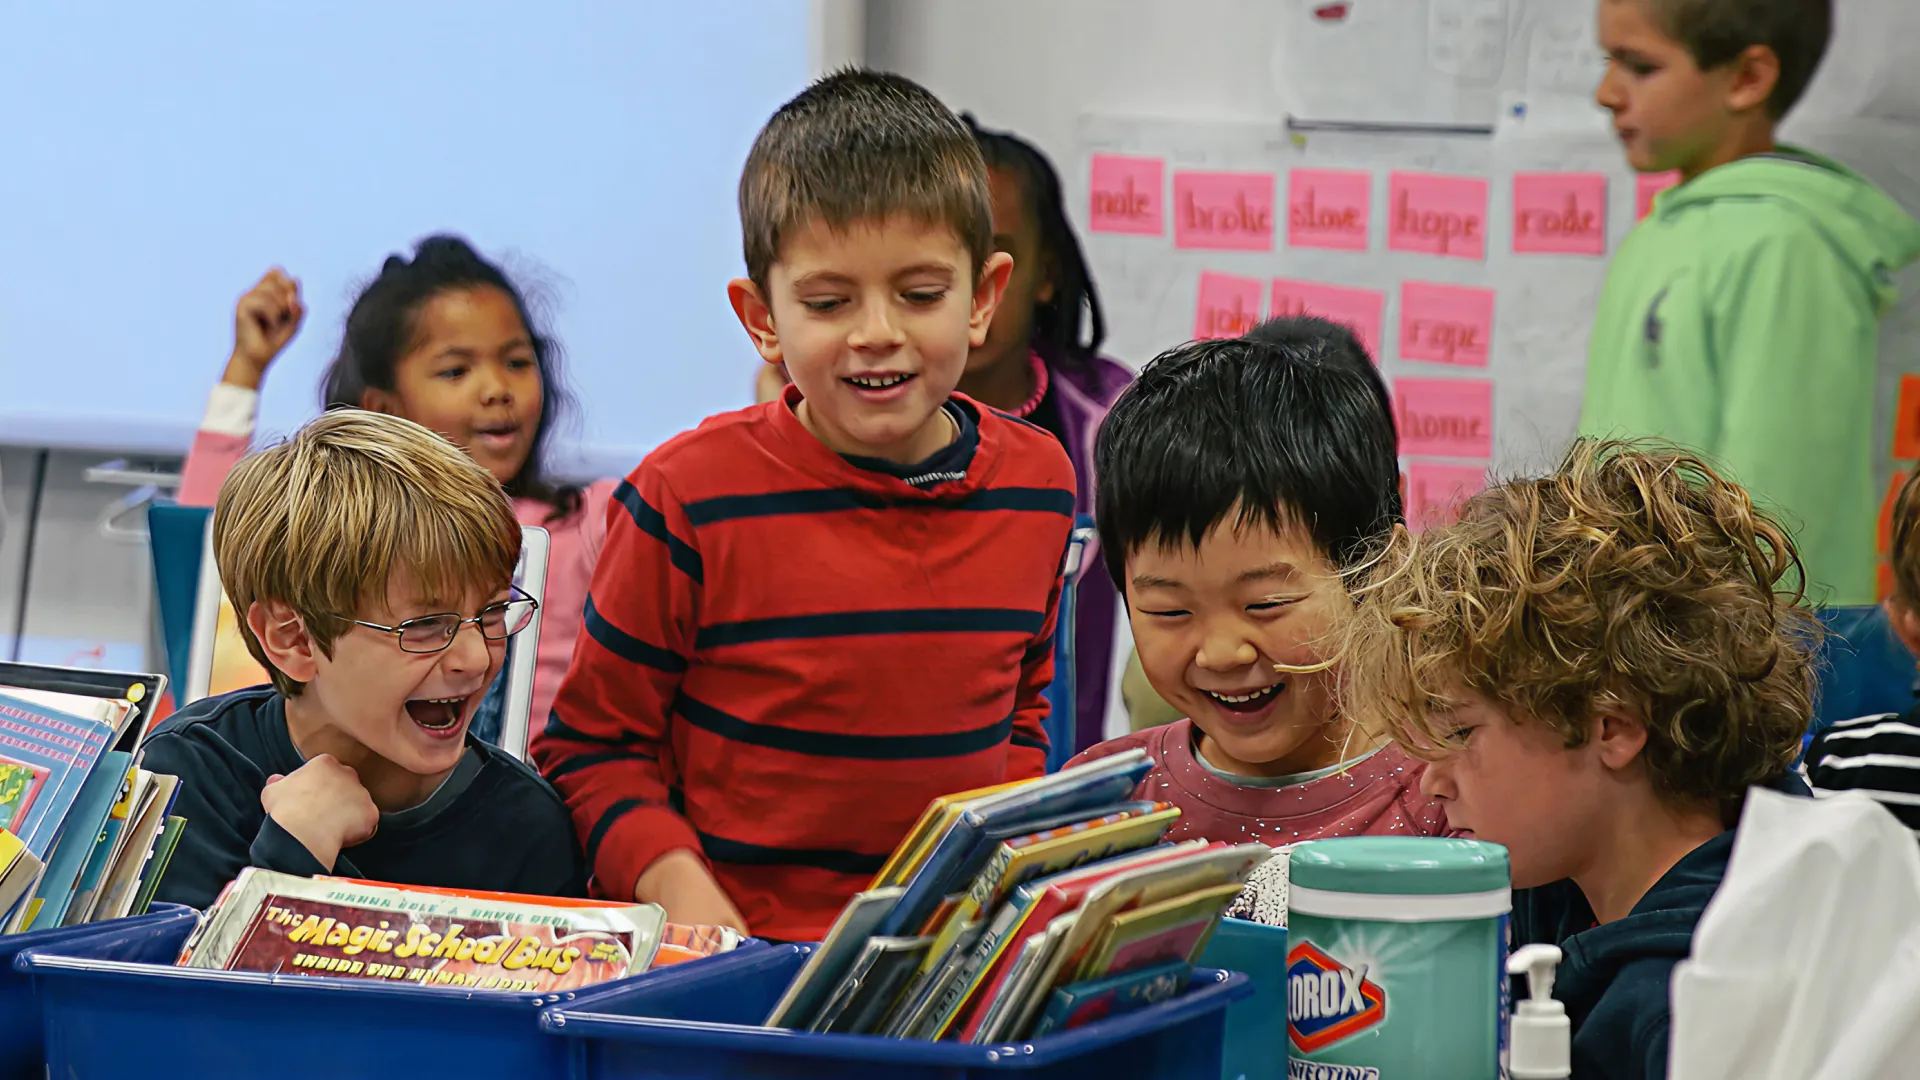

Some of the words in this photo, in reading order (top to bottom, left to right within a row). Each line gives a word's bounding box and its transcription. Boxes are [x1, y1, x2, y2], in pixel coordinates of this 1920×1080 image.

[1394, 188, 1479, 254] hope
[1515, 191, 1602, 237] rode
[1407, 318, 1486, 363] rope
[1398, 392, 1489, 443] home
[265, 906, 304, 928] The
[287, 914, 400, 956] Magic
[394, 921, 516, 965] School
[501, 935, 582, 975] Bus
[292, 953, 365, 975] INSIDE
[1287, 963, 1369, 1021] OROX
